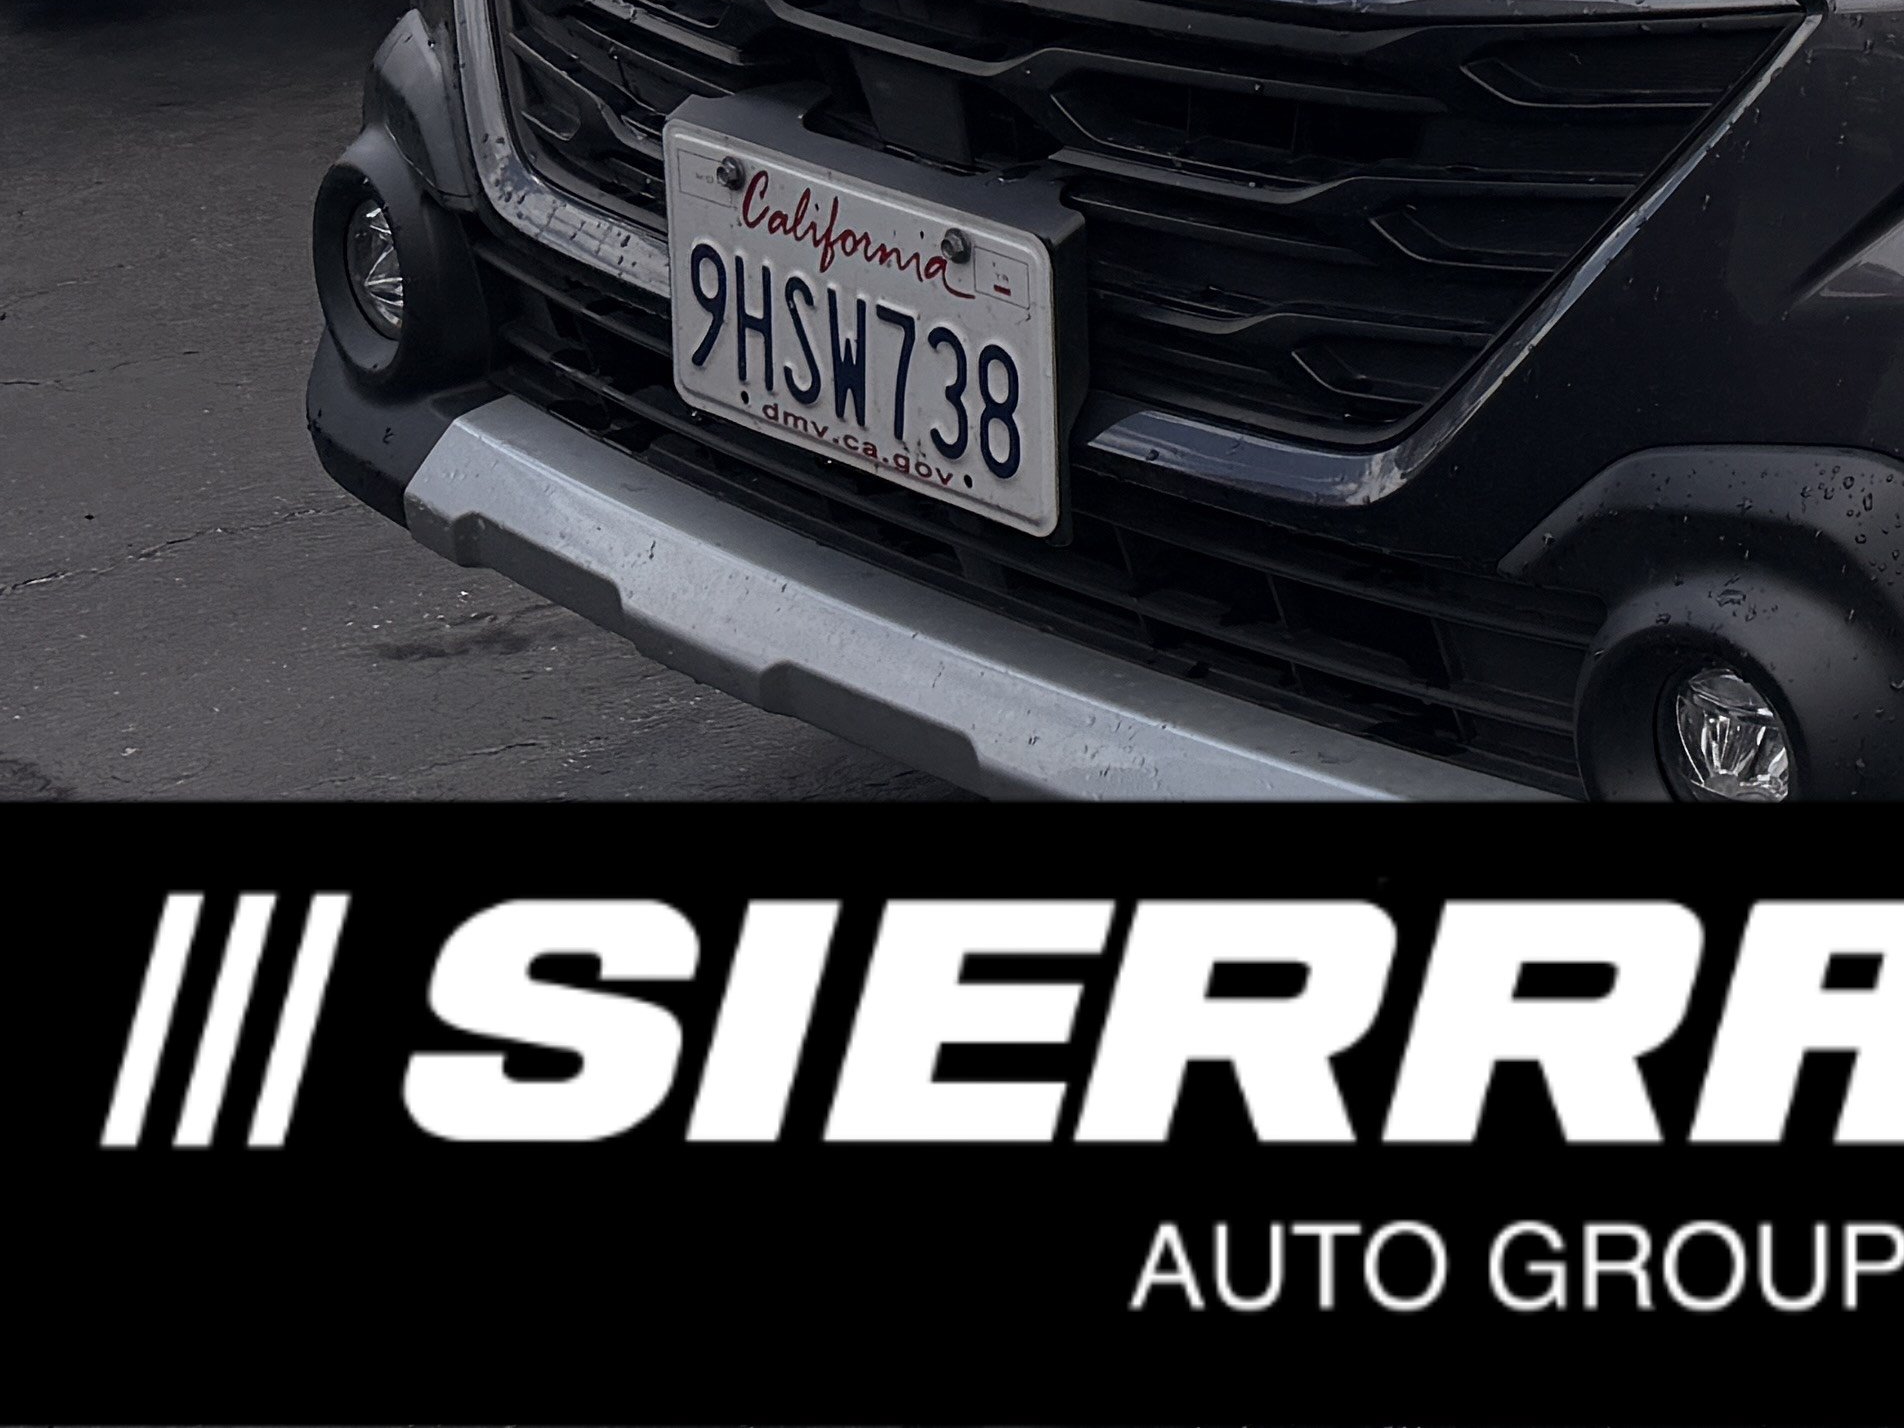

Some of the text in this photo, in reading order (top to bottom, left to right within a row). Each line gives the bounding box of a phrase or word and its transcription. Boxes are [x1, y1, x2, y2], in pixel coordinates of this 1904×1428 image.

[740, 169, 976, 300] California
[690, 242, 1022, 480] 9HSW738
[762, 402, 953, 488] dmv.ca.gov
